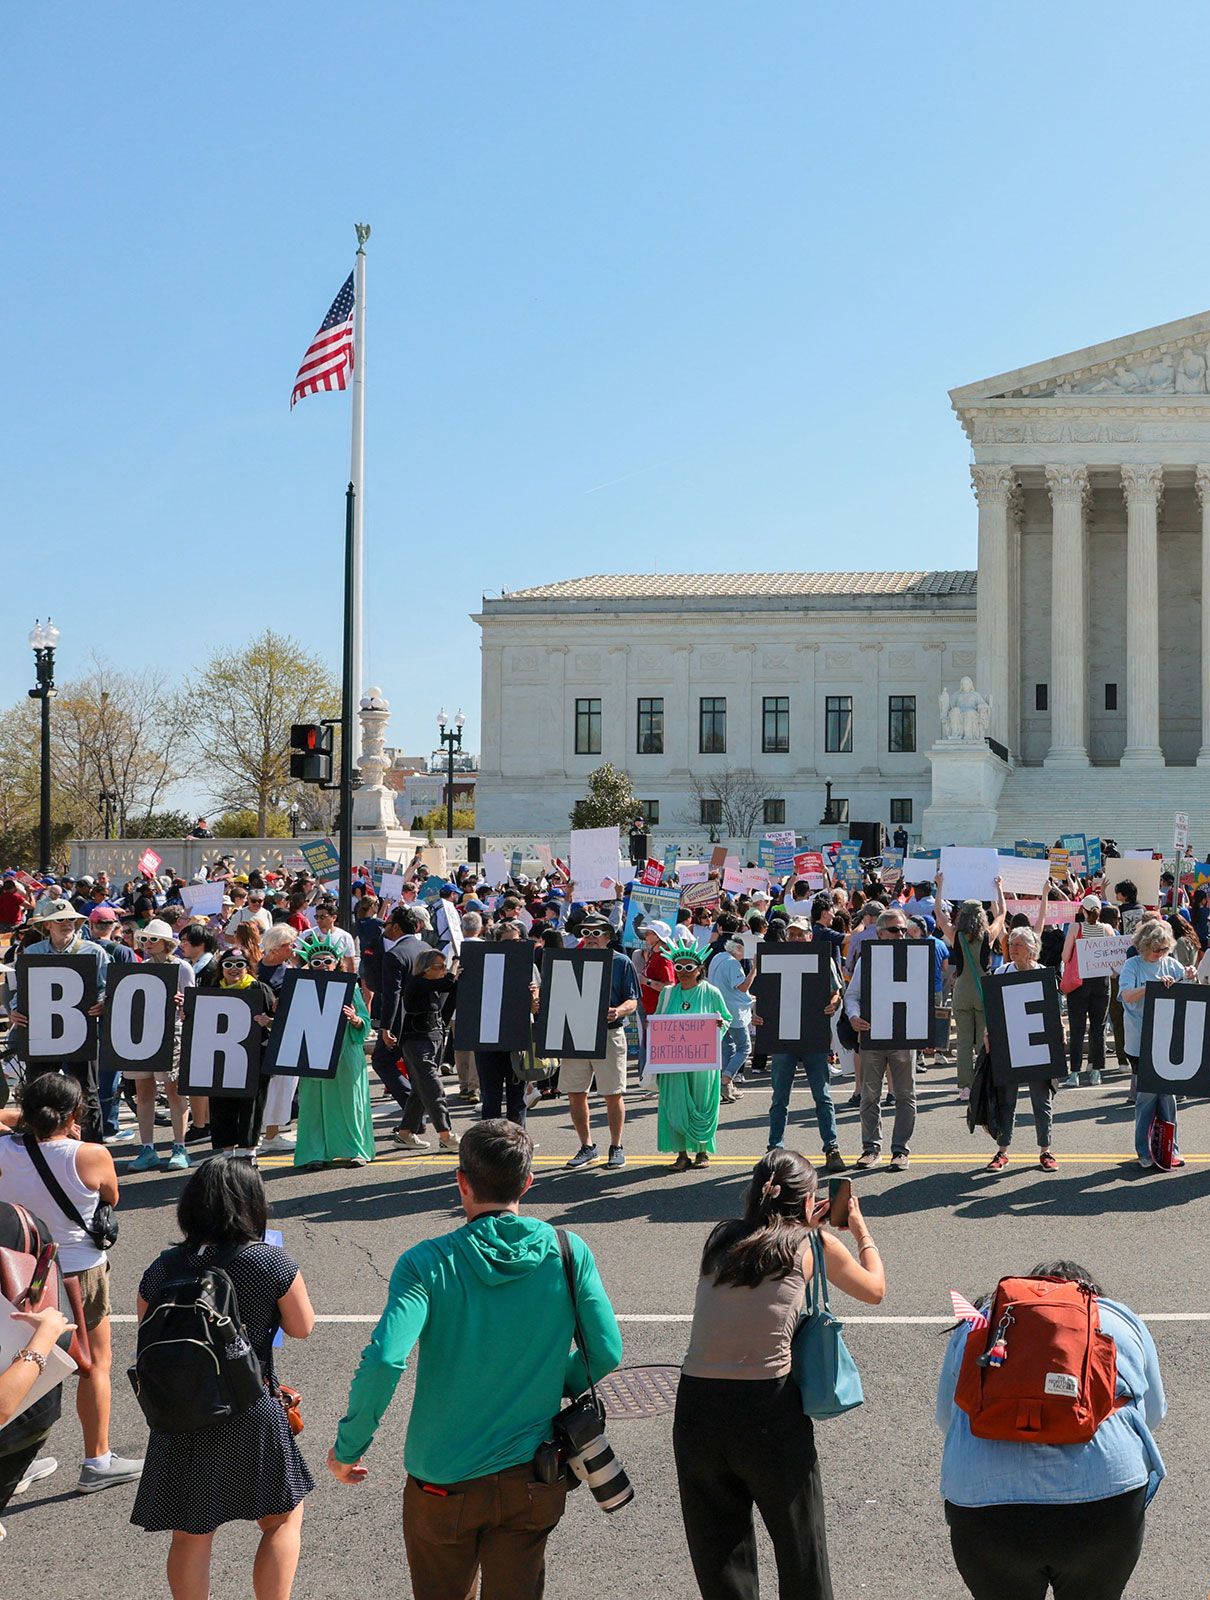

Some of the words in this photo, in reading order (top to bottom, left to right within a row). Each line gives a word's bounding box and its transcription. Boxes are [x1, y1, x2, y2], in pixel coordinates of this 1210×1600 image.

[1085, 940, 1116, 951] NACIDO
[1094, 948, 1126, 958] SIEMPR
[652, 1020, 706, 1032] CITIZENSHIP
[650, 1043, 709, 1060] BIRTHRIGHT
